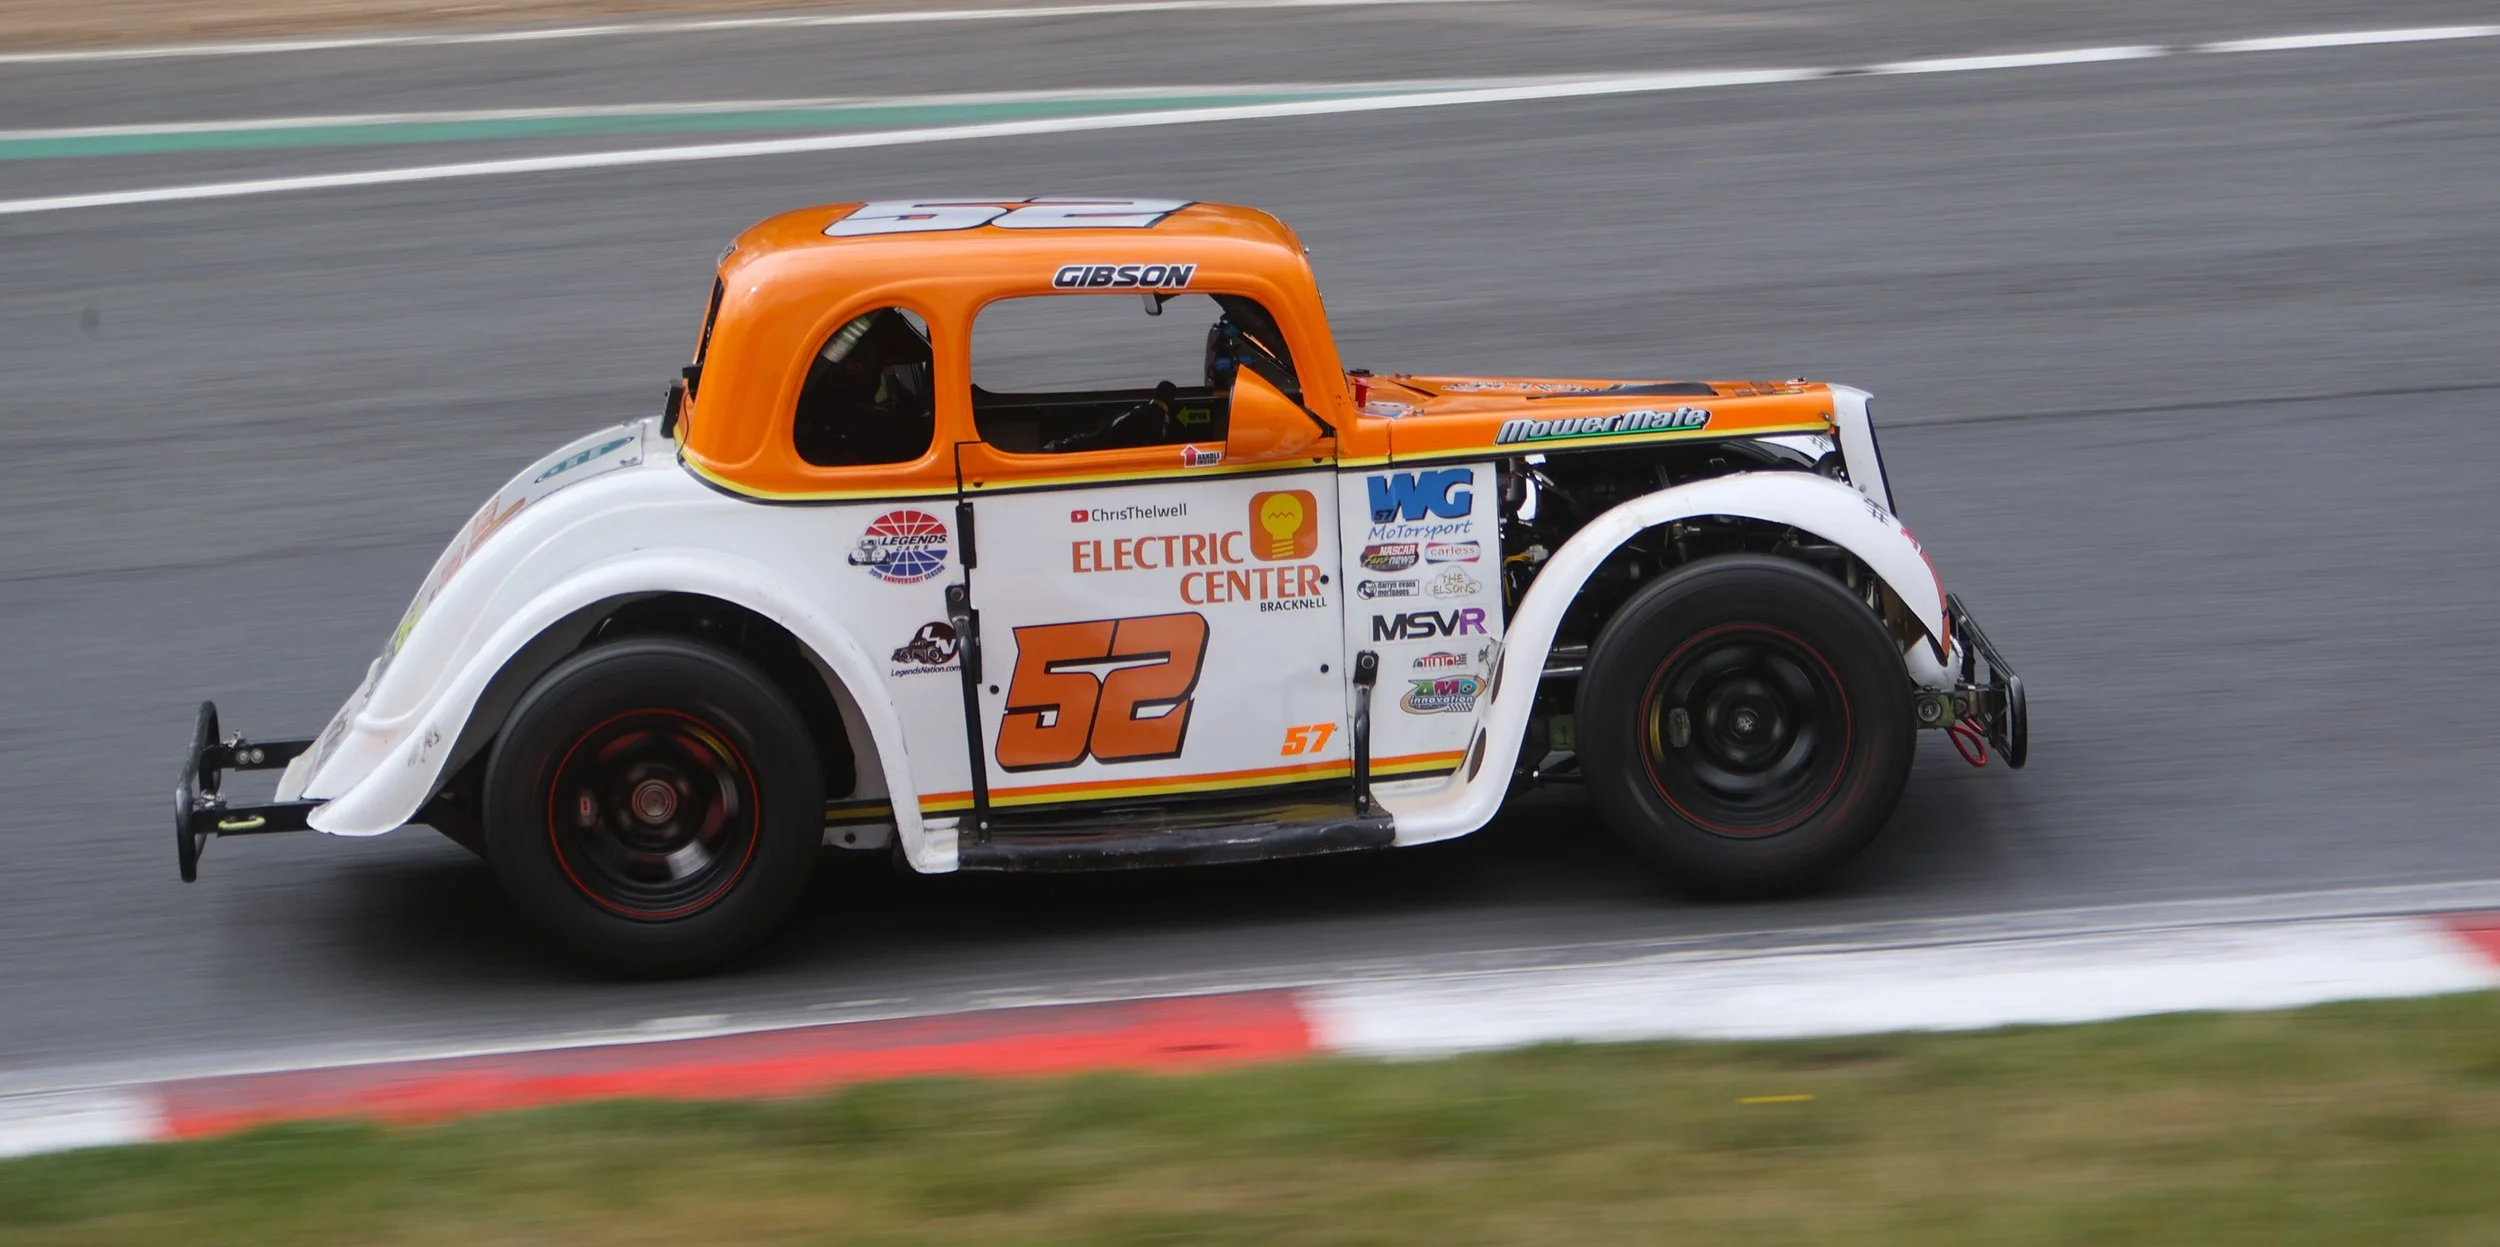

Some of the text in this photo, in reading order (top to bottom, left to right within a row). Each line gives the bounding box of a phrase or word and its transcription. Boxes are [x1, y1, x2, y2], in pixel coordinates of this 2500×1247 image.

[822, 197, 1201, 238] 52
[1052, 264, 1197, 290] GIBSON
[1496, 407, 1711, 445] MowerMate
[1197, 452, 1219, 460] HANDLE
[1367, 468, 1473, 524] WG
[1091, 503, 1187, 522] ChrisThelwell
[881, 535, 947, 546] LEGENDS
[1368, 520, 1472, 540] MoTorsport
[1072, 531, 1244, 574] ELECTRIC
[1380, 545, 1416, 556] NASCAR
[1430, 546, 1475, 558] carless
[882, 575, 924, 585] ANNIVERSARY
[924, 564, 946, 580] SEASON
[1179, 565, 1322, 605] CENTER
[1442, 573, 1463, 584] THE
[1259, 597, 1327, 613] BRACKNELL
[1372, 608, 1487, 642] MSVR
[890, 665, 961, 677] LegendsNation.com
[995, 611, 1210, 774] 52
[1280, 723, 1336, 757] 57
